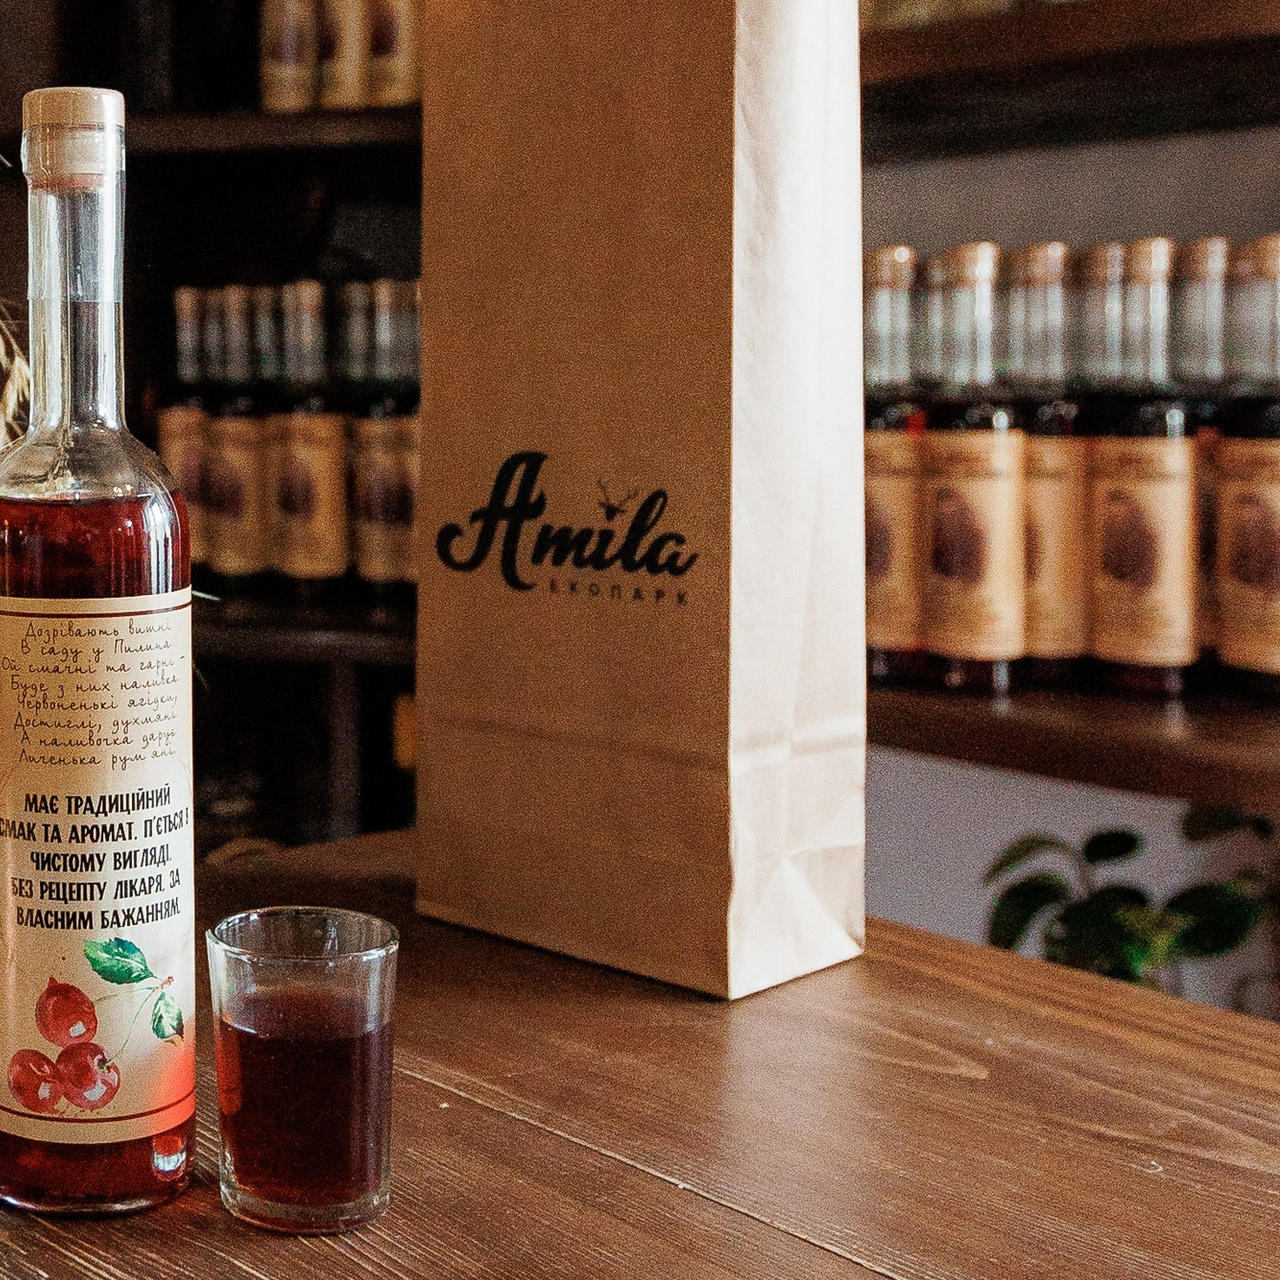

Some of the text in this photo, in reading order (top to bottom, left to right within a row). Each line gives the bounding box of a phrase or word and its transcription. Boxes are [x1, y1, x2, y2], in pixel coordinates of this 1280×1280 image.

[436, 450, 699, 591] Amila
[25, 618, 171, 644] Дозрівають вишні
[21, 639, 31, 654] В
[41, 646, 82, 663] саду
[92, 647, 104, 663] у
[2, 657, 20, 670] Ой
[29, 659, 96, 674] смачні
[106, 664, 130, 672] та
[11, 674, 48, 697] Буде
[58, 684, 65, 698] з
[76, 683, 110, 692] них
[18, 693, 118, 716] Червоненькі
[14, 711, 101, 733] Достиглі,
[21, 730, 30, 745] А
[40, 730, 133, 746] наливочка
[19, 748, 101, 765] Личенька
[24, 783, 171, 817] МАЄ ТРАДИЦІЙНИЙ
[42, 823, 61, 843] ТА
[68, 821, 137, 843] АРОМАТ.
[30, 843, 172, 871] ЧИСТОМУ ВИГЛЯДІ.
[11, 876, 33, 897] БЕЗ
[39, 882, 106, 904] РЕЦЕПТУ
[169, 867, 181, 889] ЗА
[16, 906, 93, 929] ВЛАСНИМ
